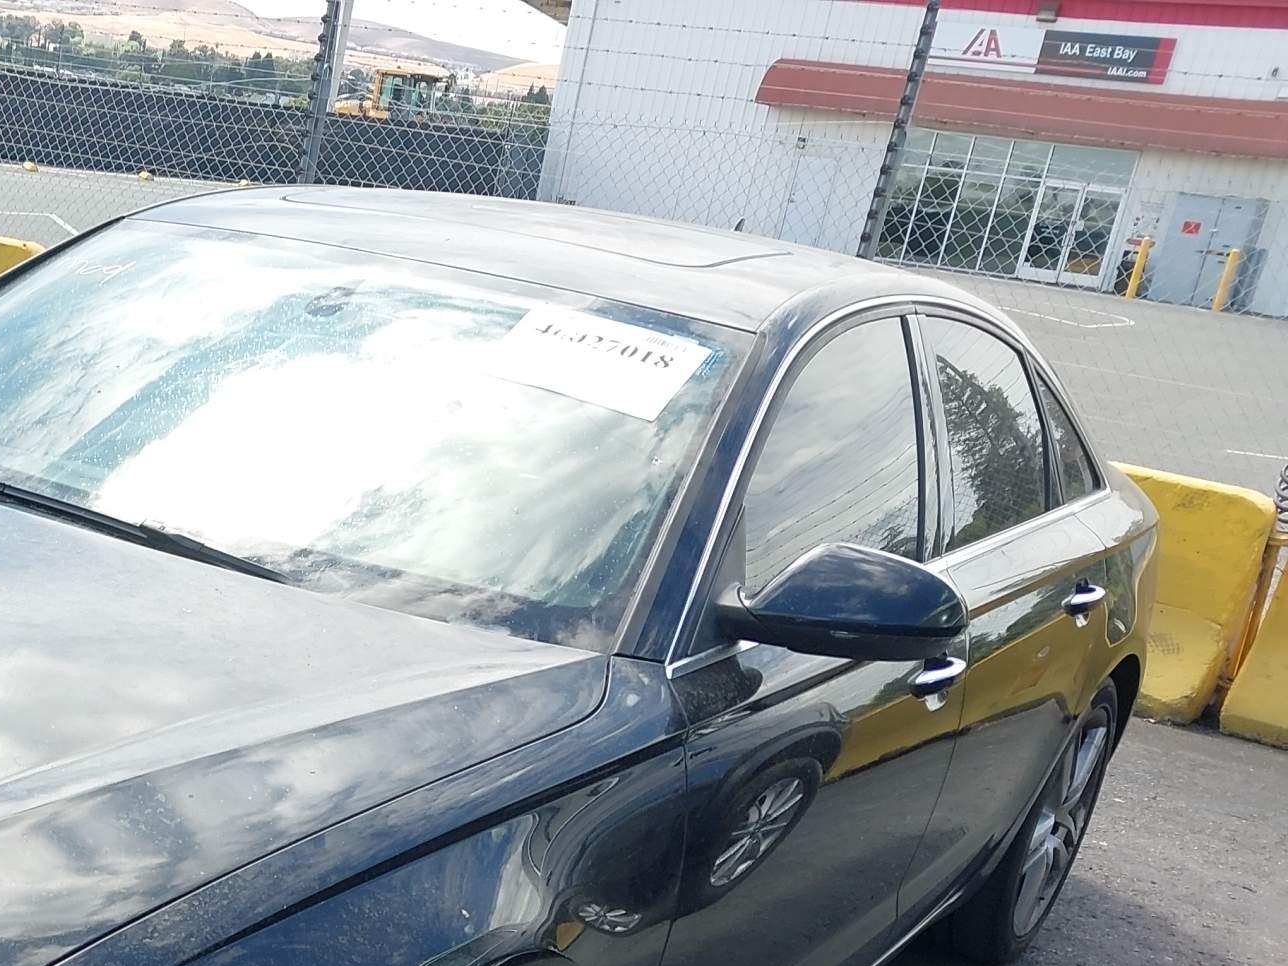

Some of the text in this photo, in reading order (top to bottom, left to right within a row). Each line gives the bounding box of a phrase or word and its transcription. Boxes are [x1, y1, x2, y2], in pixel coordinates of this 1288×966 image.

[1059, 42, 1137, 62] IAA East Bay
[536, 324, 674, 369] 427018
